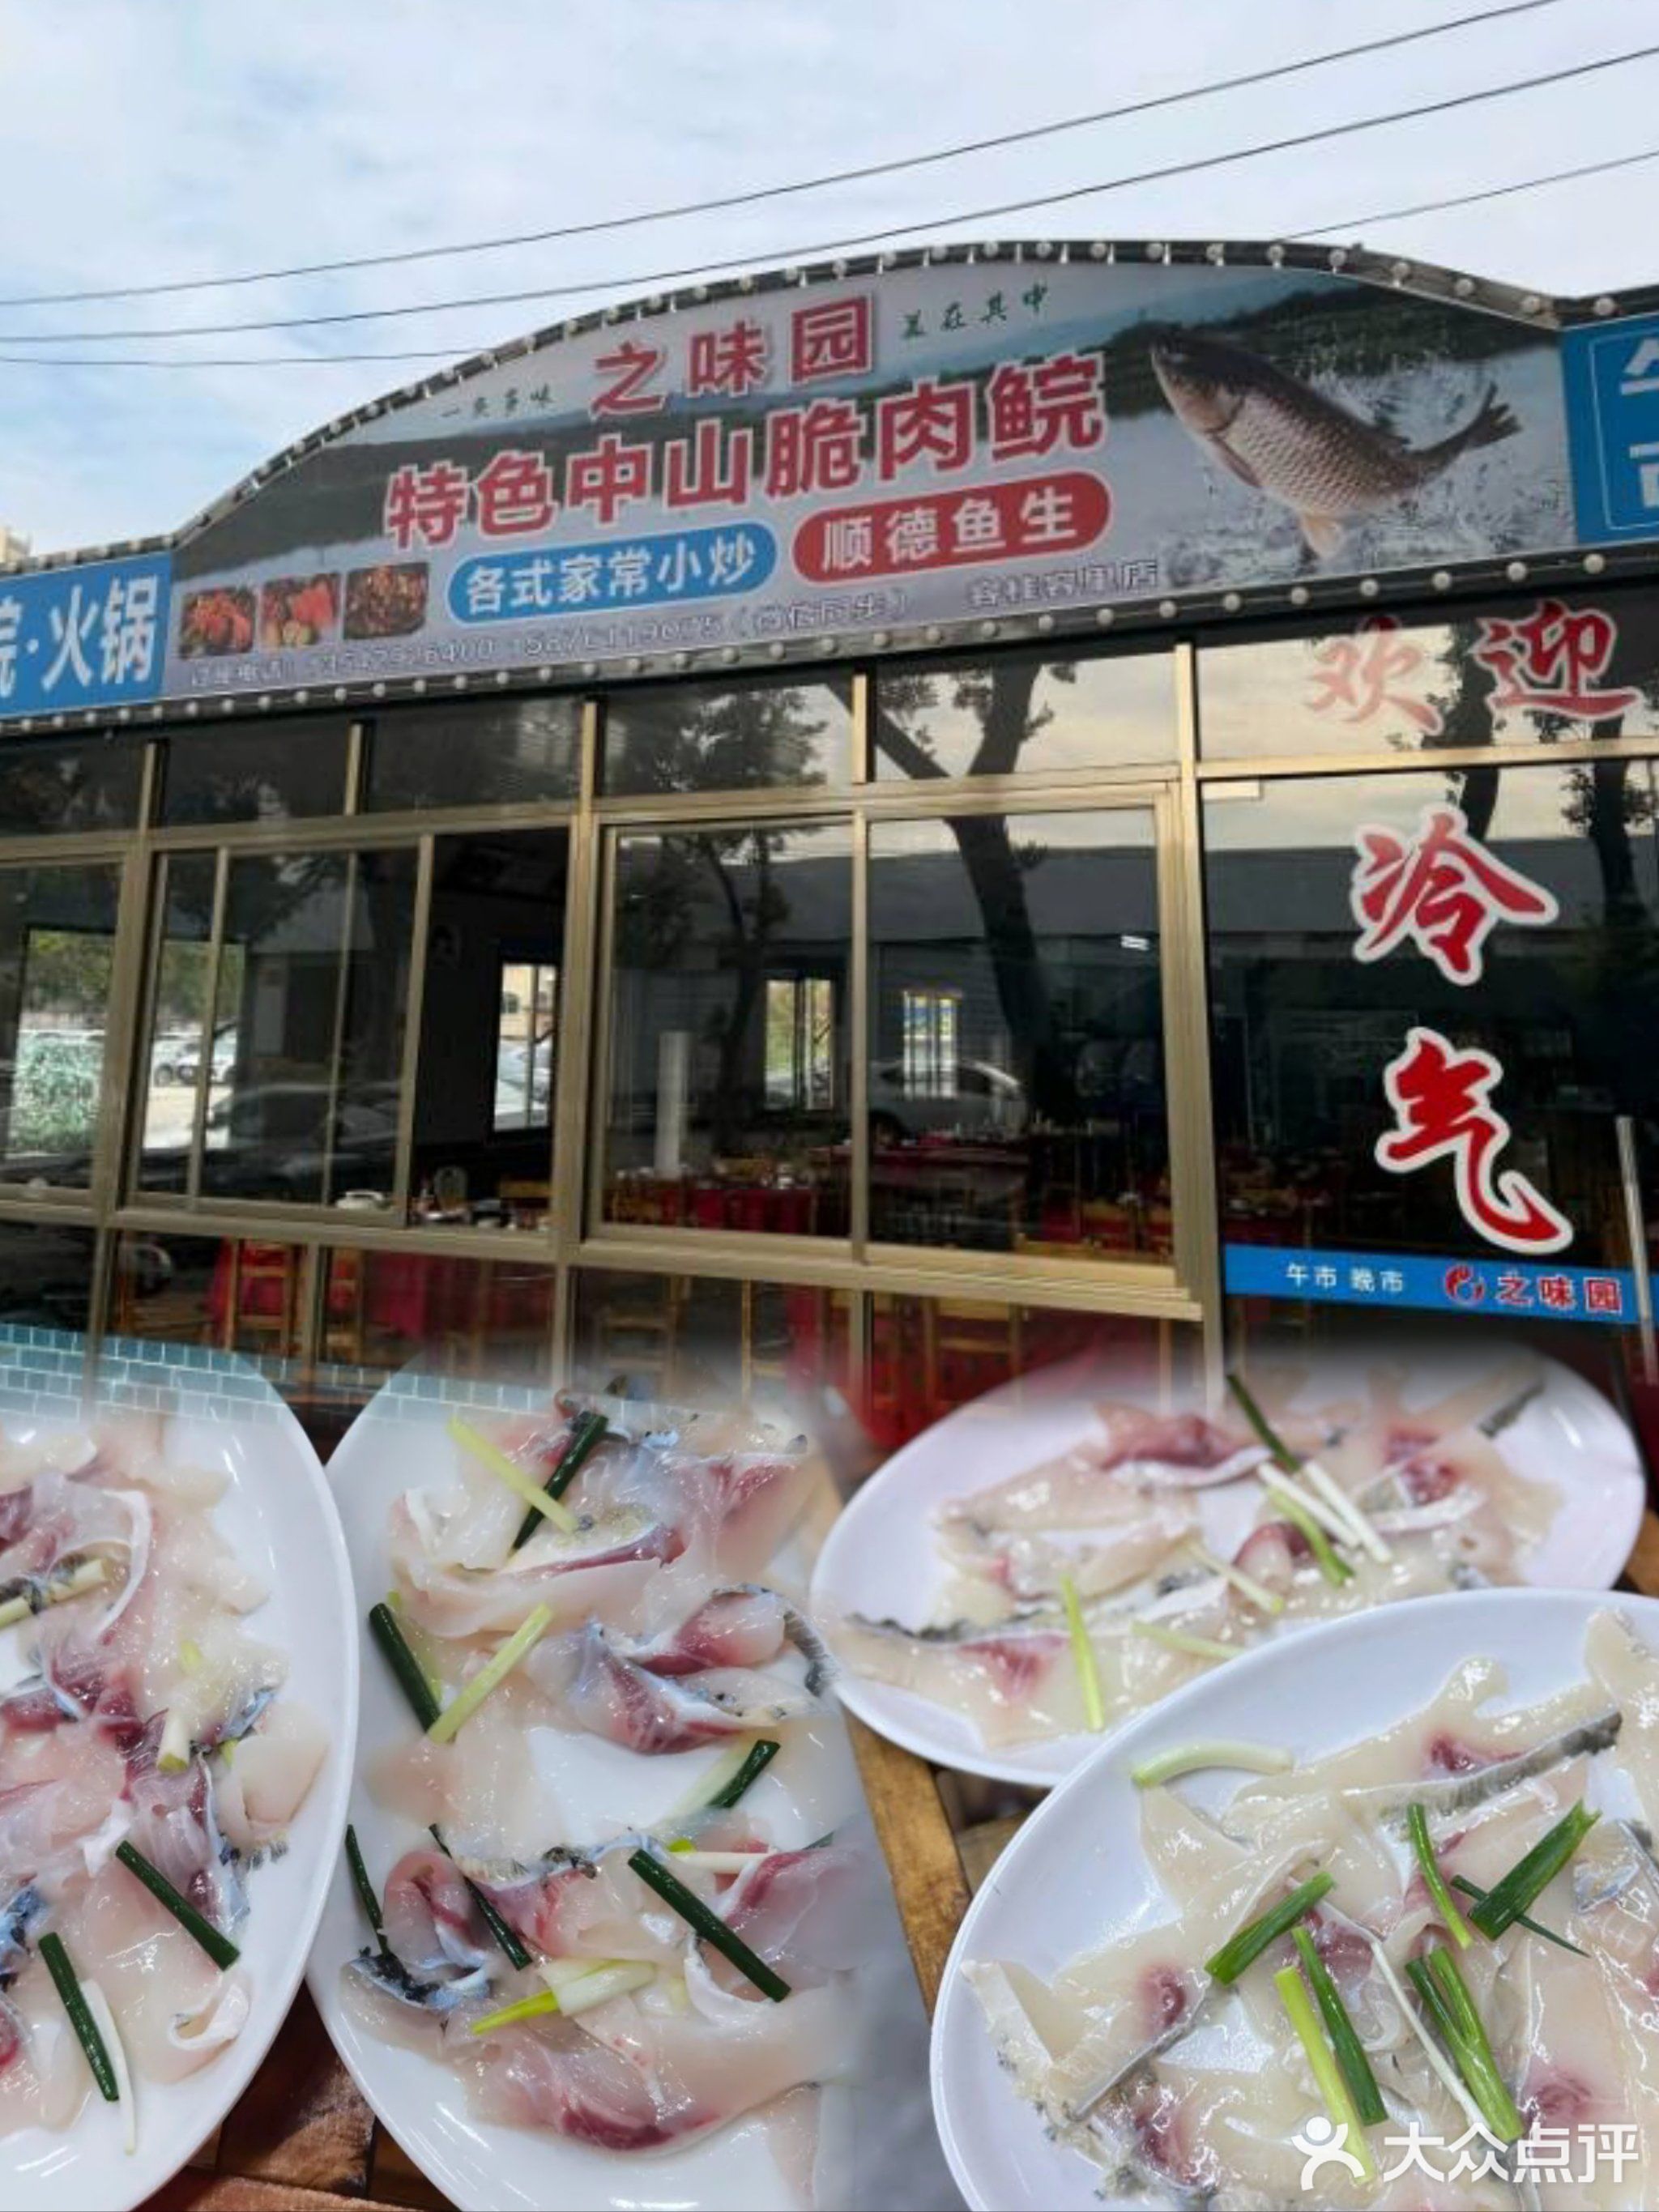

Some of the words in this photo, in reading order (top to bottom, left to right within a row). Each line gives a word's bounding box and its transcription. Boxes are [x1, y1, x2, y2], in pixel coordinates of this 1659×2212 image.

[589, 292, 872, 420] 之味园
[382, 350, 1108, 549] 特色中山脆肉鲩
[820, 487, 1078, 573] 顺德鱼生
[467, 531, 756, 616] 各式家常小炒
[1286, 1262, 1337, 1289] 午市
[1350, 1268, 1403, 1293] 晚市
[1495, 1271, 1623, 1314] 之味园
